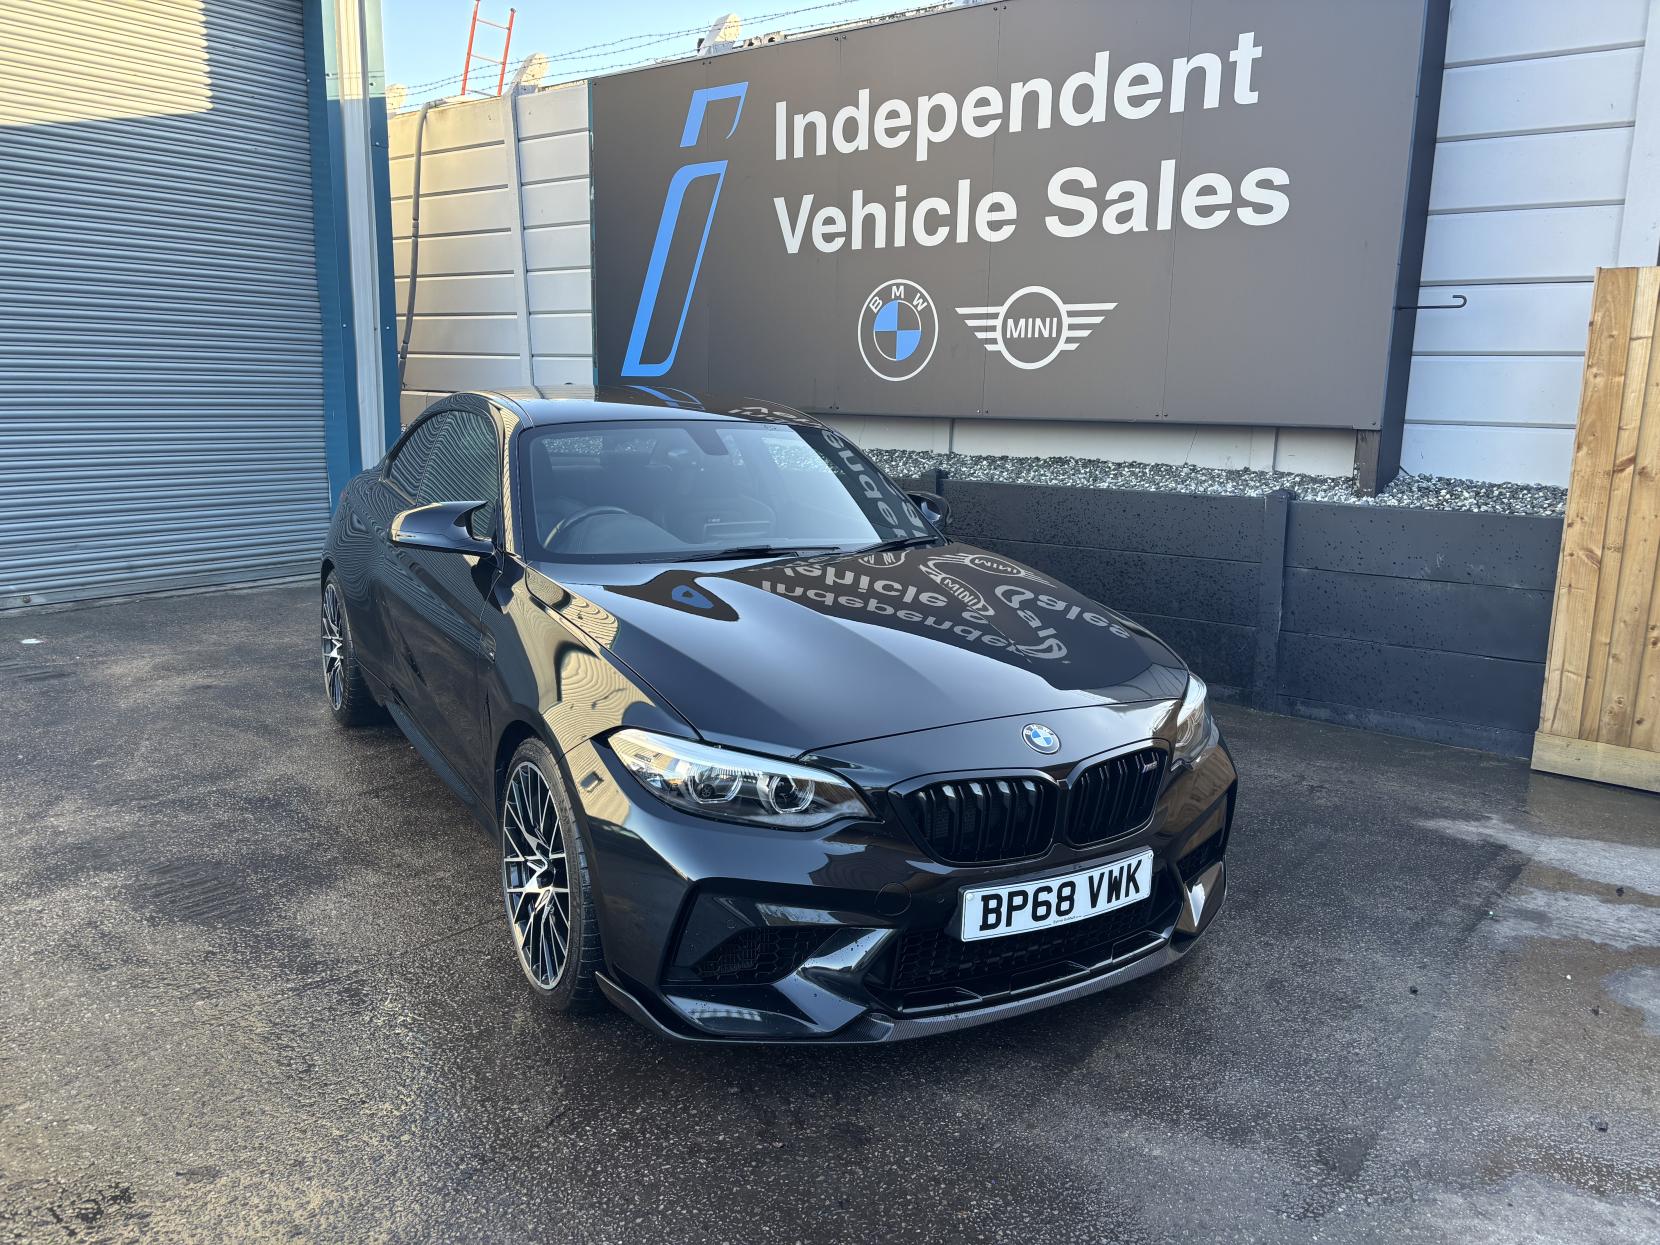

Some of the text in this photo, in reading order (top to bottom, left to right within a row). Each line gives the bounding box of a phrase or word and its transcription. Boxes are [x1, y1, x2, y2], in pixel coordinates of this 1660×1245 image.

[775, 31, 1263, 161] Independent
[773, 159, 1290, 254] Vehicle Sales
[868, 285, 928, 314] BMW
[1006, 317, 1058, 339] MINI
[979, 859, 1143, 931] BP68 VWK
